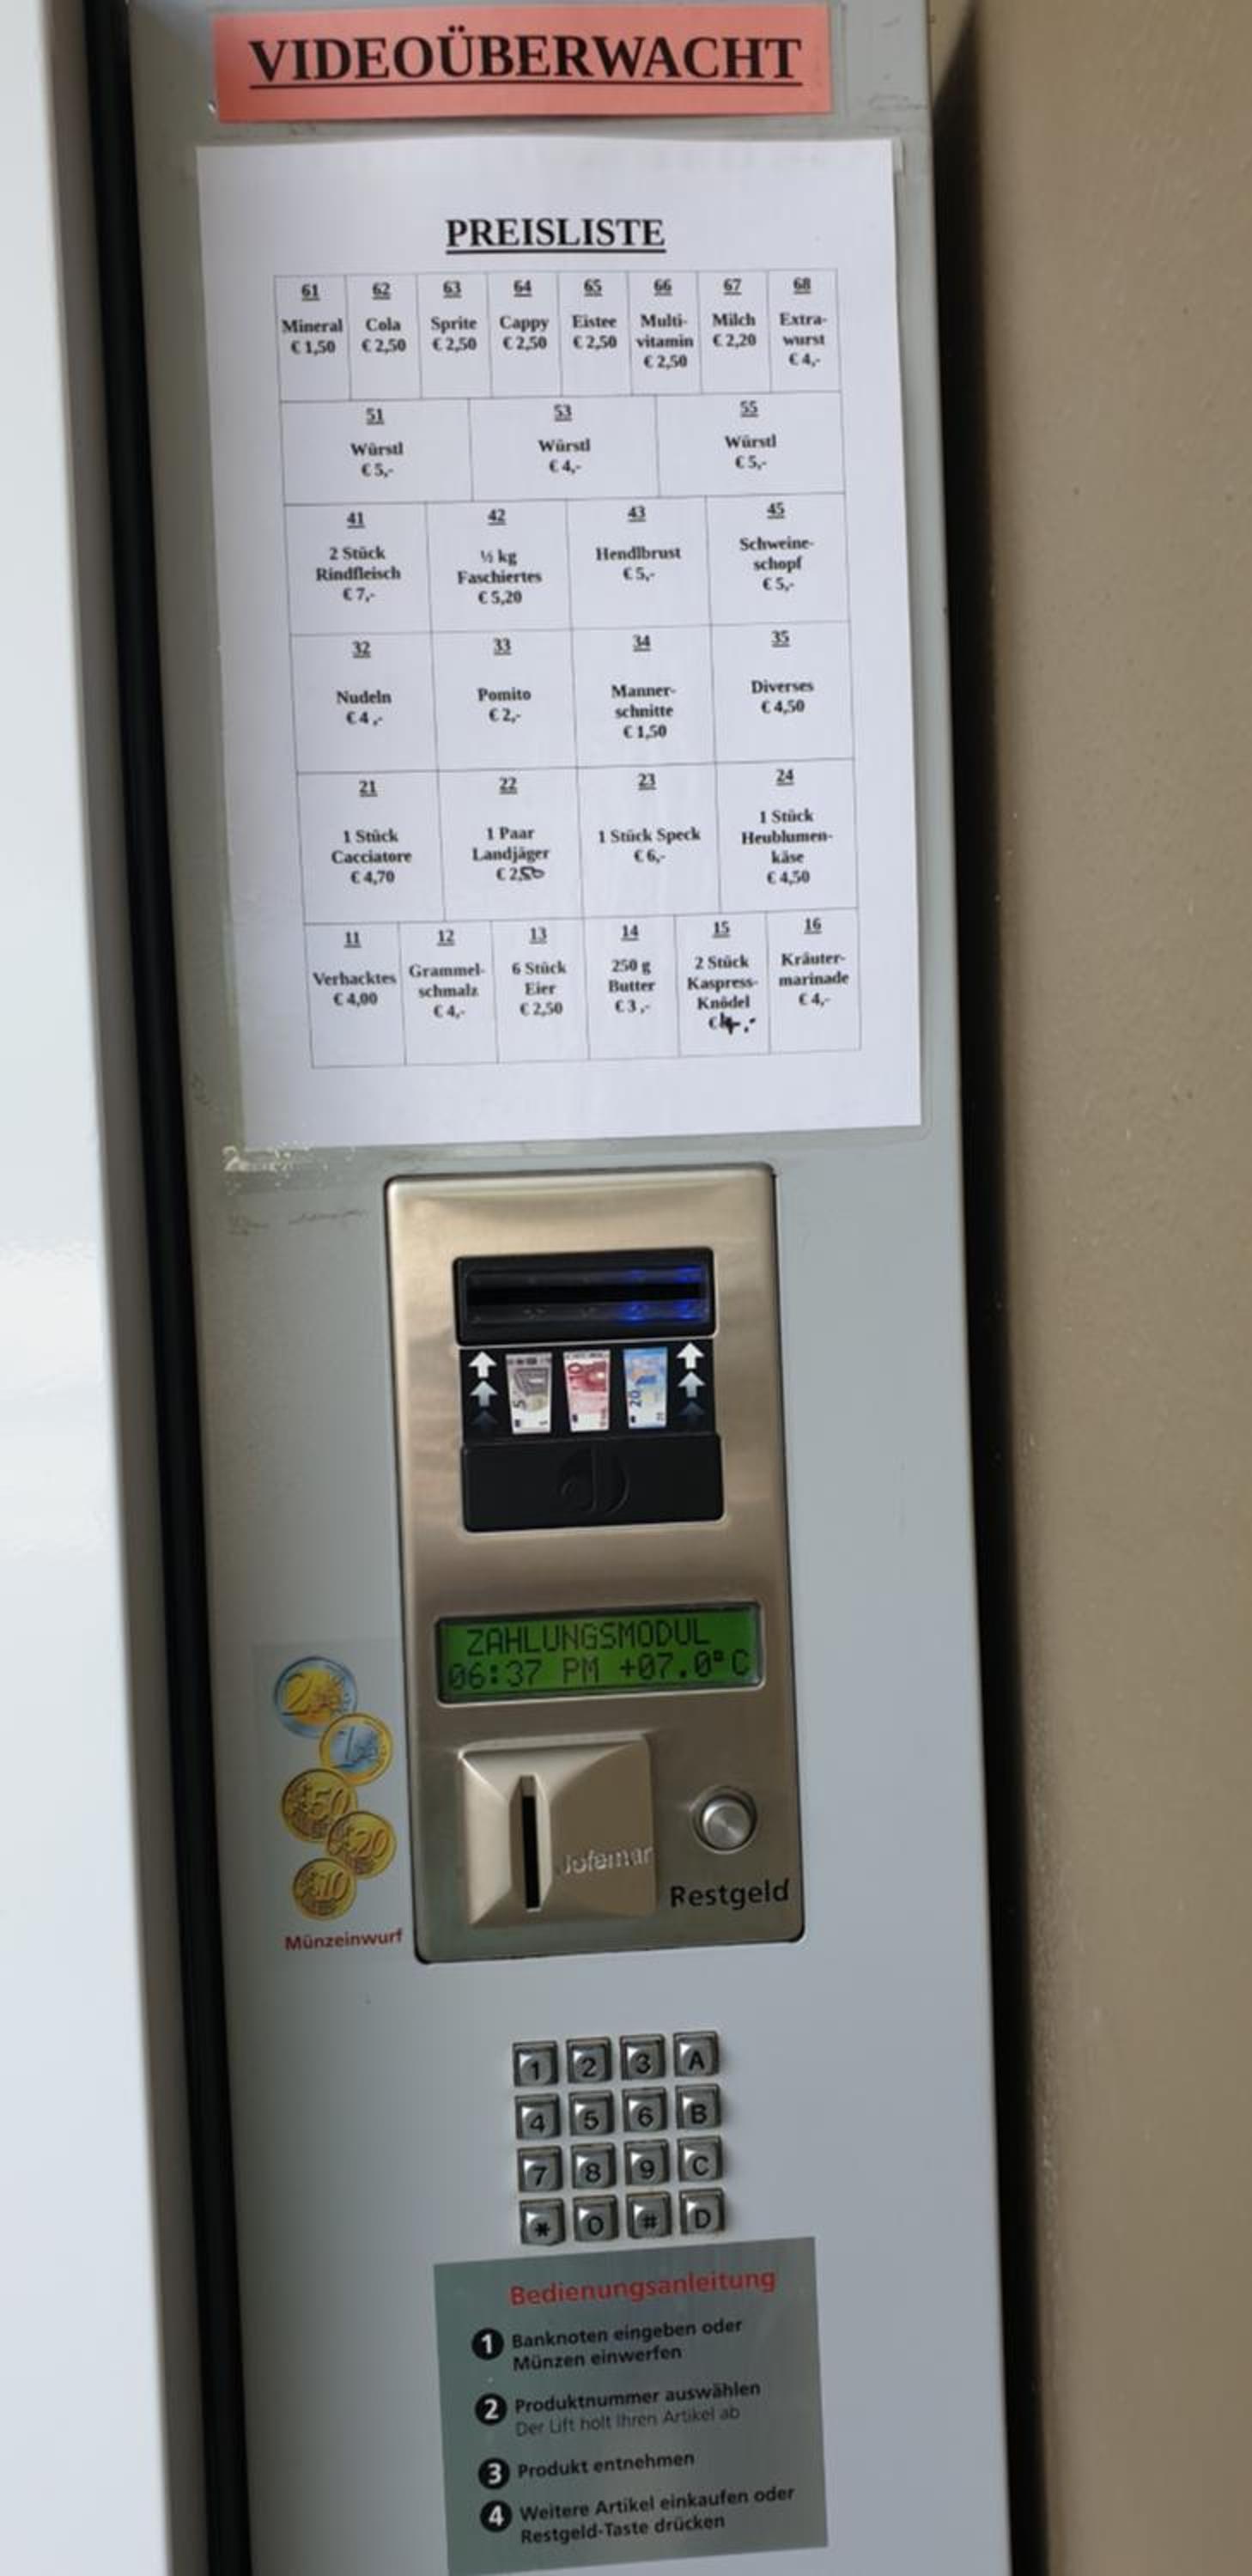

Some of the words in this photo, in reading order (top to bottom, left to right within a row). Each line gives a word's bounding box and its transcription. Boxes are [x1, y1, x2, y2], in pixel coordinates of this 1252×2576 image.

[250, 24, 802, 84] VIDEOÜBERWACHT
[447, 218, 665, 250] PREISLISTE
[301, 284, 319, 299] 61
[373, 283, 390, 298] 62
[443, 281, 461, 296] 63
[514, 280, 532, 295] 64
[584, 279, 602, 295] 65
[654, 279, 672, 295] 66
[724, 278, 741, 294] 67
[793, 277, 811, 293] 68
[282, 319, 343, 333] Mineral
[366, 317, 401, 331] Cola
[431, 316, 477, 334] Sprite
[500, 316, 549, 332] Cappy
[573, 315, 617, 328] Eistee
[640, 313, 687, 328] Multi-
[713, 313, 756, 326] Milch
[780, 313, 827, 326] Extra-
[636, 334, 694, 348] vitamin
[726, 333, 757, 348] 2,20
[783, 335, 824, 345] wurst
[367, 408, 384, 423] 51
[555, 404, 572, 420] 53
[740, 400, 758, 416] 55
[538, 439, 590, 452] Würstl
[725, 434, 776, 448] Würstl
[350, 442, 403, 456] Würstl
[748, 455, 767, 471] 5,-
[488, 509, 505, 524] 42
[628, 506, 645, 521] 43
[768, 502, 785, 518] 45
[347, 512, 364, 527] 41
[739, 536, 814, 552] Schweine-
[330, 547, 337, 560] 2
[343, 546, 385, 560] Stück
[498, 550, 517, 566] kg
[596, 546, 680, 561] Hendlbrust
[753, 556, 801, 572] schopf
[316, 566, 400, 581] Rindfleisch
[458, 570, 542, 584] Faschiertes
[491, 591, 522, 605] 5,20
[634, 635, 650, 651] 34
[772, 630, 789, 646] 35
[353, 641, 370, 657] 32
[495, 638, 511, 654] 33
[478, 687, 531, 702] Pomito
[611, 684, 676, 699] Manner-
[751, 680, 814, 694] Diverses
[337, 690, 392, 704] Nudeln
[616, 704, 673, 718] schnitte
[638, 725, 666, 739] 1,50
[639, 774, 655, 788] 23
[777, 769, 793, 784] 24
[360, 781, 377, 795] 21
[500, 777, 517, 793] 22
[761, 811, 766, 823] 1
[772, 809, 813, 823] Stück
[344, 830, 350, 843] 1
[356, 829, 398, 843] Stück
[488, 828, 493, 840] 1
[500, 827, 534, 840] Paar
[599, 830, 605, 843] 1
[611, 829, 652, 842] Stück
[657, 827, 701, 845] Speck
[742, 830, 833, 845] Heublumen-
[331, 850, 411, 864] Cacciatore
[472, 847, 550, 865] Landjäger
[771, 850, 804, 864] käse
[780, 870, 810, 885] 4,50
[623, 925, 638, 939] 14
[714, 920, 730, 937] 15
[805, 918, 821, 933] 16
[345, 932, 361, 946] 11
[438, 930, 454, 945] 12
[531, 927, 547, 943] 13
[696, 957, 703, 969] 2
[708, 955, 749, 969] Stück
[781, 951, 846, 966] Kräuter-
[409, 963, 486, 978] Grammel-
[512, 963, 521, 975] 6
[526, 961, 566, 975] Stück
[612, 959, 637, 972] 250
[641, 962, 651, 975] g
[313, 971, 396, 986] Verhacktes
[688, 976, 758, 993] Kaspress-
[779, 971, 848, 987] marinade
[419, 983, 478, 998] schmalz
[526, 982, 556, 995] Eier
[609, 980, 655, 993] Butter
[347, 993, 378, 1007] 4,00
[698, 995, 750, 1010] Knödel
[467, 1619, 712, 1653] ZAHLUNGSMODUL
[448, 1659, 542, 1691] 06:37
[562, 1658, 600, 1684] PM
[669, 1878, 790, 1911] Restgeld
[284, 1929, 404, 1952] Münzeinwurf
[531, 2062, 539, 2080] 1
[581, 2057, 596, 2078] 2
[636, 2054, 651, 2075] 3
[688, 2050, 704, 2071] A
[530, 2114, 545, 2133] 4
[584, 2111, 599, 2130] 5
[638, 2107, 653, 2128] 6
[691, 2104, 706, 2124] B
[532, 2166, 547, 2186] 7
[586, 2162, 601, 2183] 8
[639, 2160, 654, 2179] 9
[692, 2155, 709, 2176] C
[696, 2208, 711, 2229] D
[508, 2269, 776, 2306] Bedienungsanleitung
[482, 2334, 495, 2354] 1
[512, 2329, 608, 2349] Banknoten
[613, 2321, 696, 2345] eingeben
[701, 2318, 743, 2336] oder
[513, 2350, 586, 2372] Münzen
[590, 2344, 682, 2366] einwerfen
[483, 2400, 499, 2420] 2
[514, 2388, 659, 2415] Produktnummer
[665, 2381, 761, 2403] auswählen
[515, 2420, 544, 2437] Der
[549, 2416, 576, 2433] Lift
[580, 2414, 611, 2432] holt
[616, 2411, 657, 2429] Ihren
[662, 2408, 714, 2425] Artikel
[719, 2405, 740, 2421] ab
[487, 2464, 501, 2484] 3
[518, 2458, 588, 2479] Produkt
[593, 2451, 695, 2474] entnehmen
[489, 2506, 505, 2527] 4
[520, 2502, 590, 2523] Weitere
[595, 2495, 655, 2517] Artikel
[659, 2488, 749, 2512] einkaufen
[753, 2486, 795, 2504] oder
[520, 2518, 649, 2545] Restgeld-Taste
[654, 2514, 726, 2535] drücken
